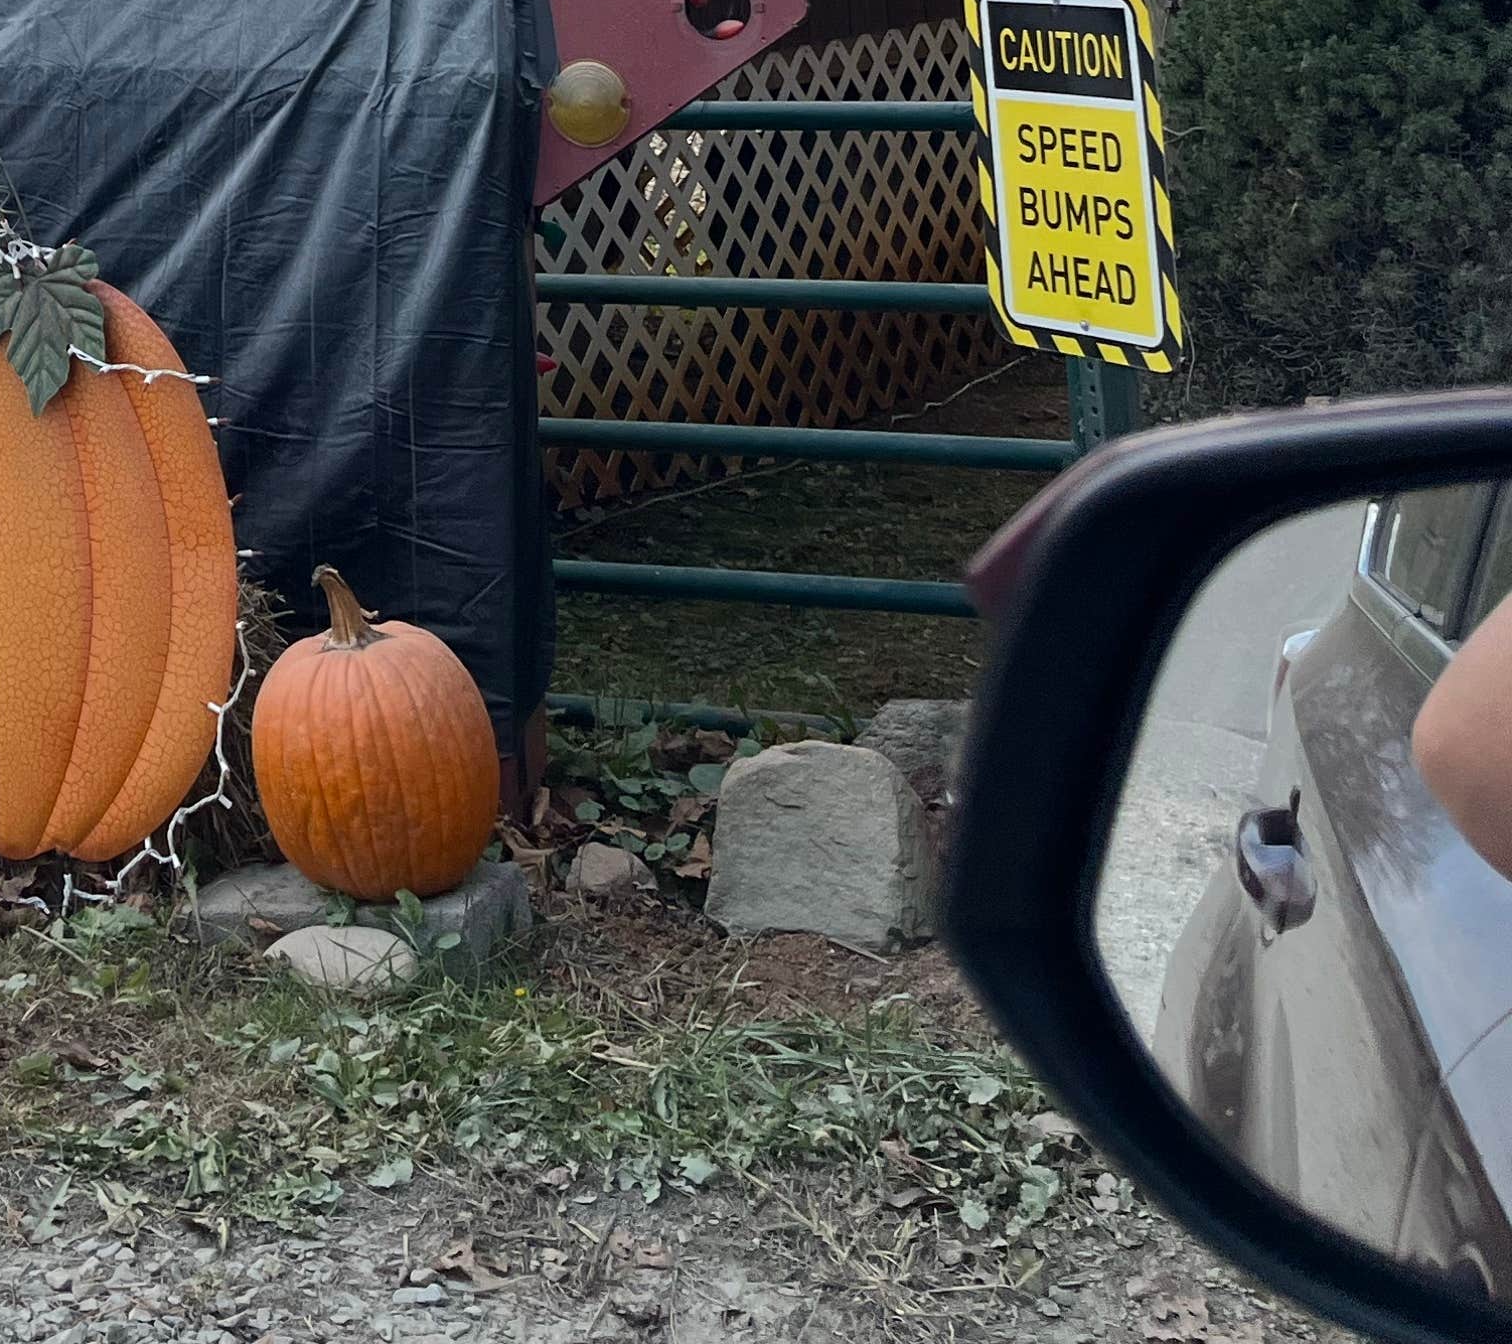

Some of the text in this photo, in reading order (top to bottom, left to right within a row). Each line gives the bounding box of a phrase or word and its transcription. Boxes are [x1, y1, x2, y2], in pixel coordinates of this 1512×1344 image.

[999, 27, 1123, 80] CAUTION
[1018, 123, 1122, 173] SPEED
[1019, 186, 1133, 240] BUMPS
[1027, 250, 1136, 306] AHEAD
